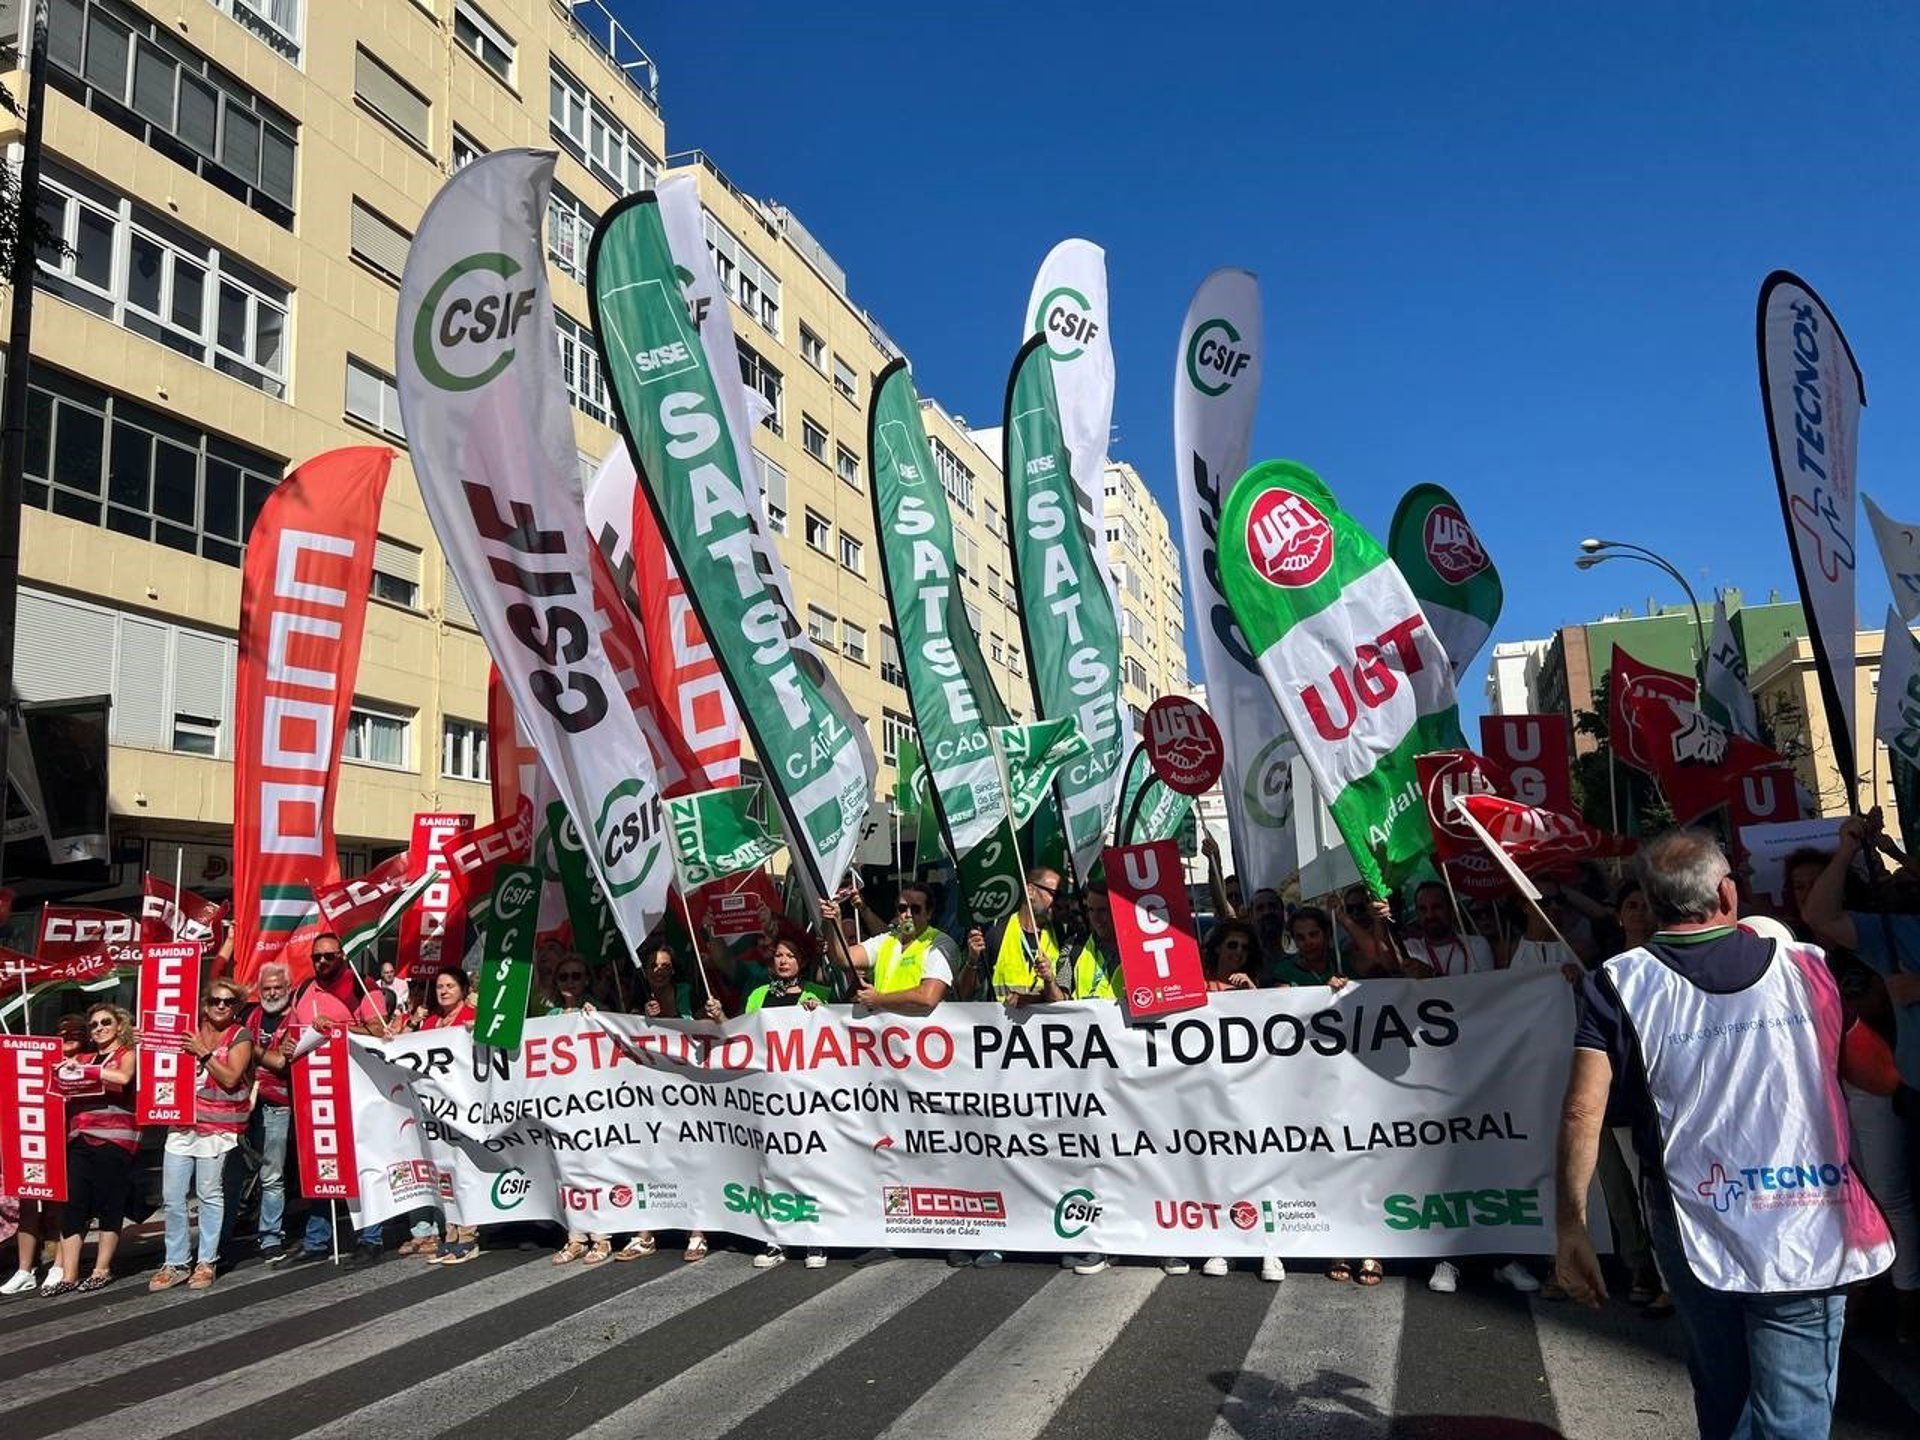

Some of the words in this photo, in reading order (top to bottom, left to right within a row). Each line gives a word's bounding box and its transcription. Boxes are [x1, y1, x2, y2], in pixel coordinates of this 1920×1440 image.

[439, 286, 536, 348] CSIF
[1048, 306, 1099, 345] CSIF
[1199, 339, 1251, 378] CSIF
[1790, 299, 1828, 482] TECNOS
[1027, 455, 1056, 476] ATSE
[1252, 496, 1317, 558] UGT
[659, 391, 813, 732] SATSE
[460, 480, 608, 735] CSIF
[893, 496, 983, 725] SATSE
[1027, 489, 1117, 745] SATSE
[260, 528, 355, 858] CCOO
[1300, 613, 1425, 742] UGT
[1150, 704, 1210, 746] UGT
[935, 731, 989, 761] CÁD
[1504, 721, 1547, 806] UG
[419, 817, 468, 827] SANIDAD
[604, 792, 662, 869] CSIF
[502, 885, 538, 906] CSIF
[1122, 848, 1175, 979] UGT
[148, 947, 195, 958] SANIDAD
[486, 927, 519, 1038] CSIF
[154, 957, 183, 1078] CCO
[1713, 1019, 1766, 1036] SUPERIOR
[3, 1038, 57, 1051] SANIDAD
[472, 1044, 511, 1083] UN
[525, 1030, 755, 1078] ESTATUTO
[767, 1025, 956, 1073] MARCO
[972, 1023, 1119, 1070] PARA
[1140, 998, 1460, 1068] TODOS/AS
[16, 1050, 47, 1161] CCOO
[148, 1108, 181, 1120] CÁDIZ
[308, 1041, 340, 1155] CCOO
[468, 1080, 654, 1126] CLASIFICACIÓN
[661, 1084, 719, 1107] CON
[724, 1082, 899, 1118] ADECUACIÓN
[908, 1090, 1107, 1119] RETRIBUTIVA
[528, 1127, 639, 1152] PARCIAL
[645, 1121, 664, 1144] Y
[678, 1120, 828, 1155] ANTICIPADA
[905, 1129, 1050, 1159] MEJORAS
[1057, 1132, 1101, 1158] EN
[1110, 1131, 1157, 1157] LA
[1165, 1125, 1335, 1157] JORNADA
[1343, 1112, 1528, 1152] LABORAL
[17, 1184, 55, 1198] CÁDIZ
[314, 1184, 348, 1196] CÁDIZ
[500, 1178, 532, 1195] CSIF
[723, 1182, 819, 1223] SATSE
[916, 1193, 984, 1212] CCOO
[1276, 1199, 1317, 1209] Servicios
[885, 1217, 920, 1226] sindicato
[921, 1218, 932, 1226] de
[933, 1218, 966, 1227] sanidad
[973, 1219, 1007, 1228] sectores
[1064, 1203, 1103, 1223] CSIF
[1153, 1199, 1222, 1231] UGT
[1277, 1210, 1316, 1221] Públicos
[1382, 1188, 1543, 1232] SATSE
[885, 1226, 945, 1235] sociosanitarios
[946, 1226, 957, 1235] de
[958, 1226, 980, 1236] Cádiz
